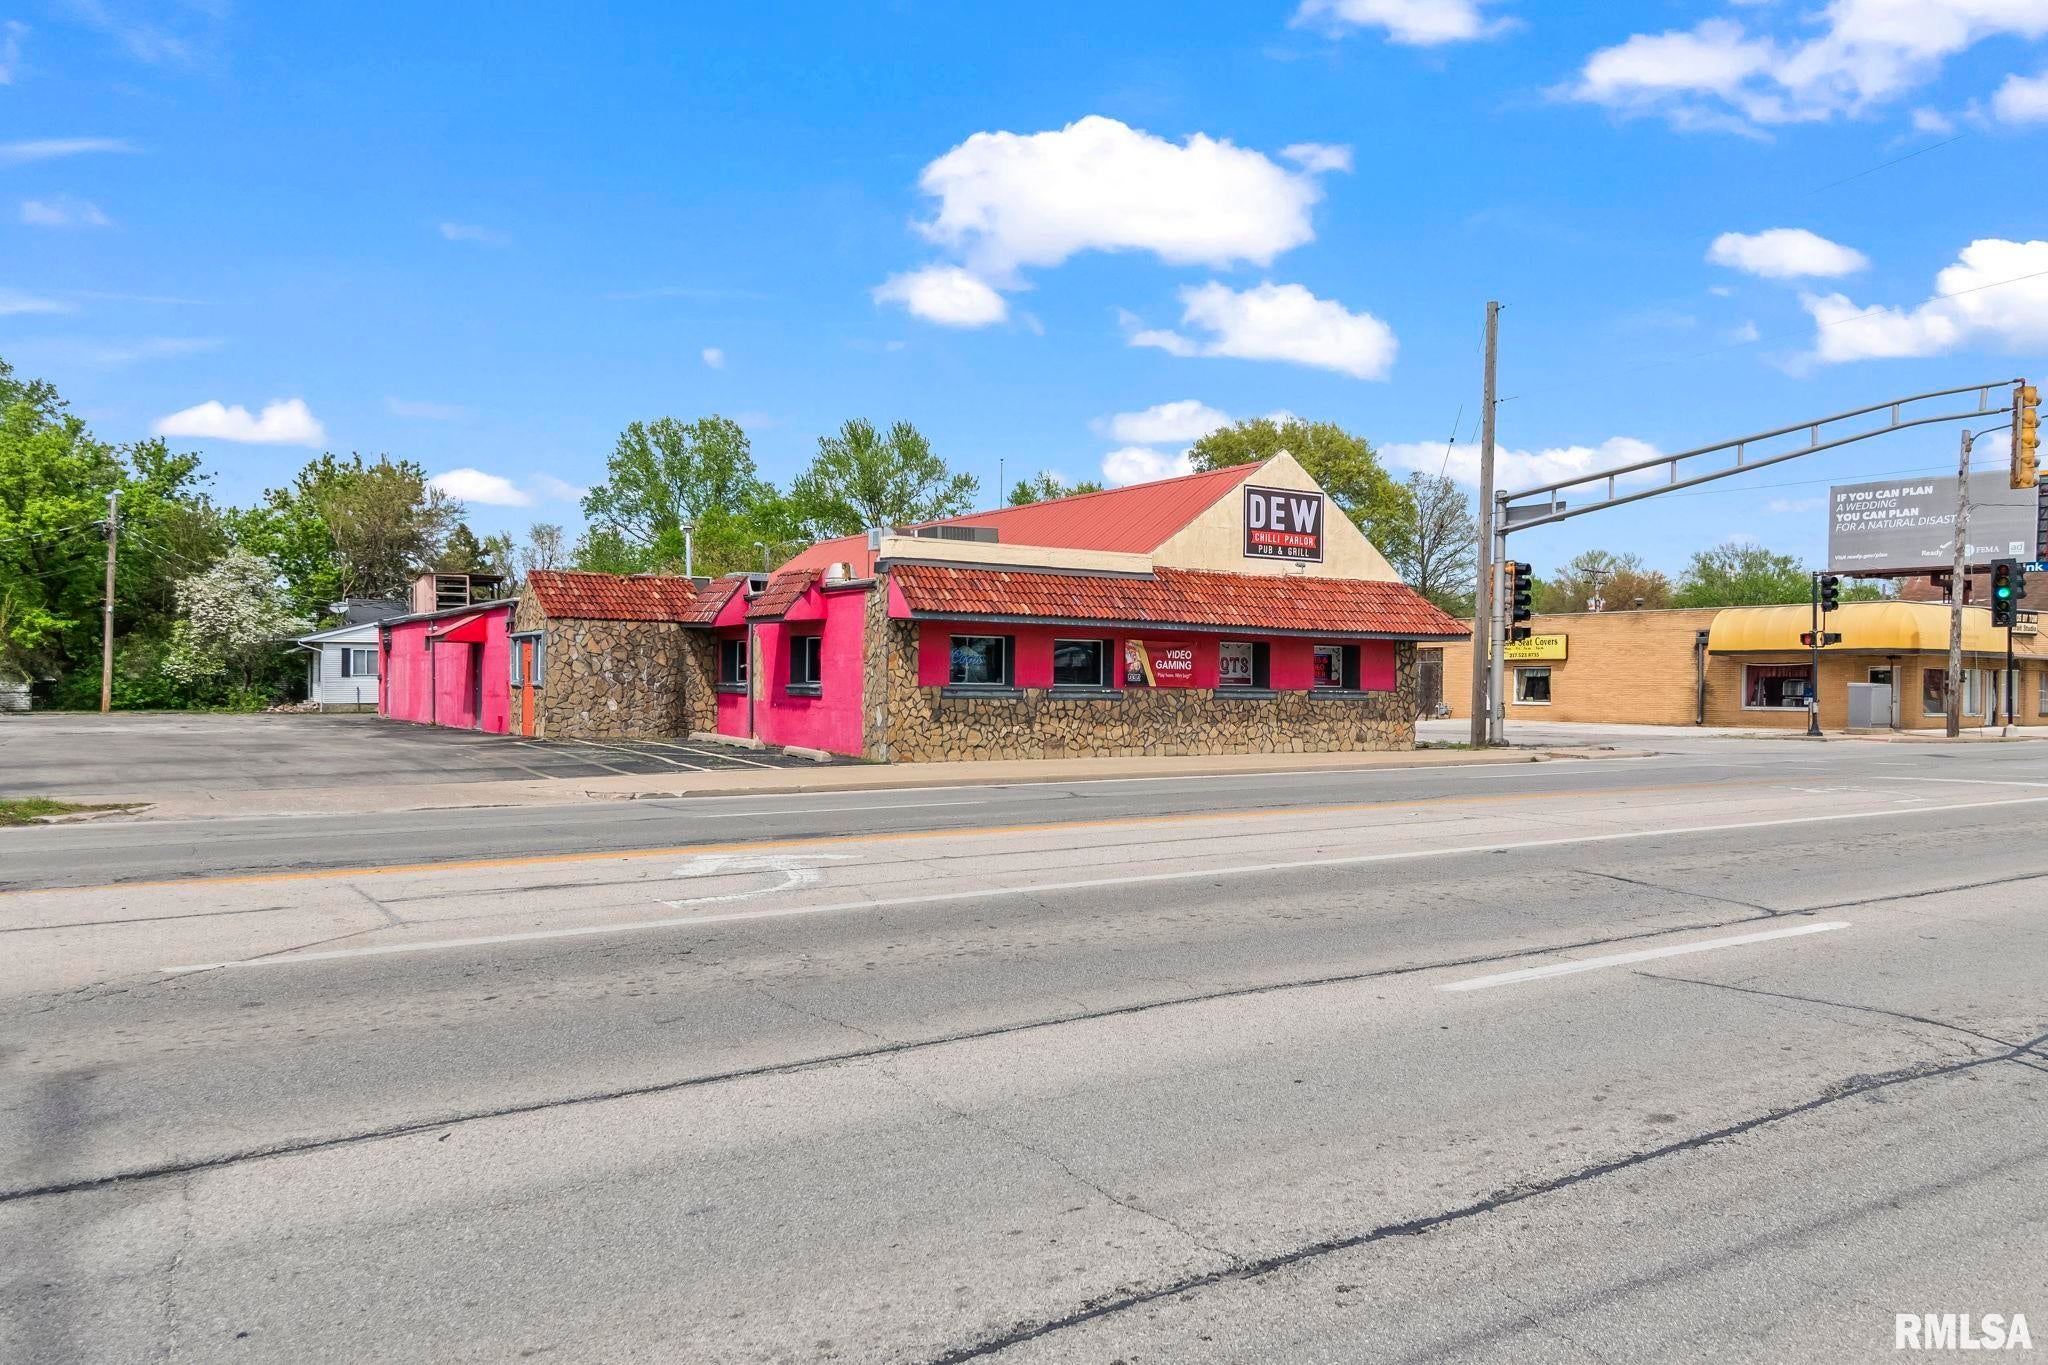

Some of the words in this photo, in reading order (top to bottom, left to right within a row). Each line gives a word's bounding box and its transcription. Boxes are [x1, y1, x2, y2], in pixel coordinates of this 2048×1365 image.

[1836, 494, 1848, 503] IF
[1848, 491, 1873, 502] YOU
[1875, 488, 1900, 499] CAN
[1902, 485, 1934, 498] PLAN
[1836, 503, 1844, 512] A
[1846, 499, 1897, 512] WEDDING
[1250, 494, 1319, 534] DEW
[1836, 512, 1860, 523] YOU
[1862, 510, 1886, 520] CAN
[1888, 507, 1919, 519] PLAN
[1836, 522, 1857, 533] FOR
[1857, 521, 1866, 530] A
[1867, 518, 1916, 530] NATURAL
[1917, 514, 1971, 526] DISAST?
[1254, 532, 1280, 544] CHILLI
[1284, 535, 1314, 546] PARLOR
[1258, 545, 1273, 554] PUB
[1277, 546, 1283, 555] &
[1287, 547, 1310, 557] GRILL
[1921, 549, 1944, 558] Ready
[1975, 545, 2000, 553] FEMA
[2023, 562, 2044, 572] nk
[1517, 637, 1533, 647] Seat
[1535, 636, 1558, 646] Covers
[1165, 650, 1192, 660] VIDEO
[1155, 660, 1192, 670] GAMING
